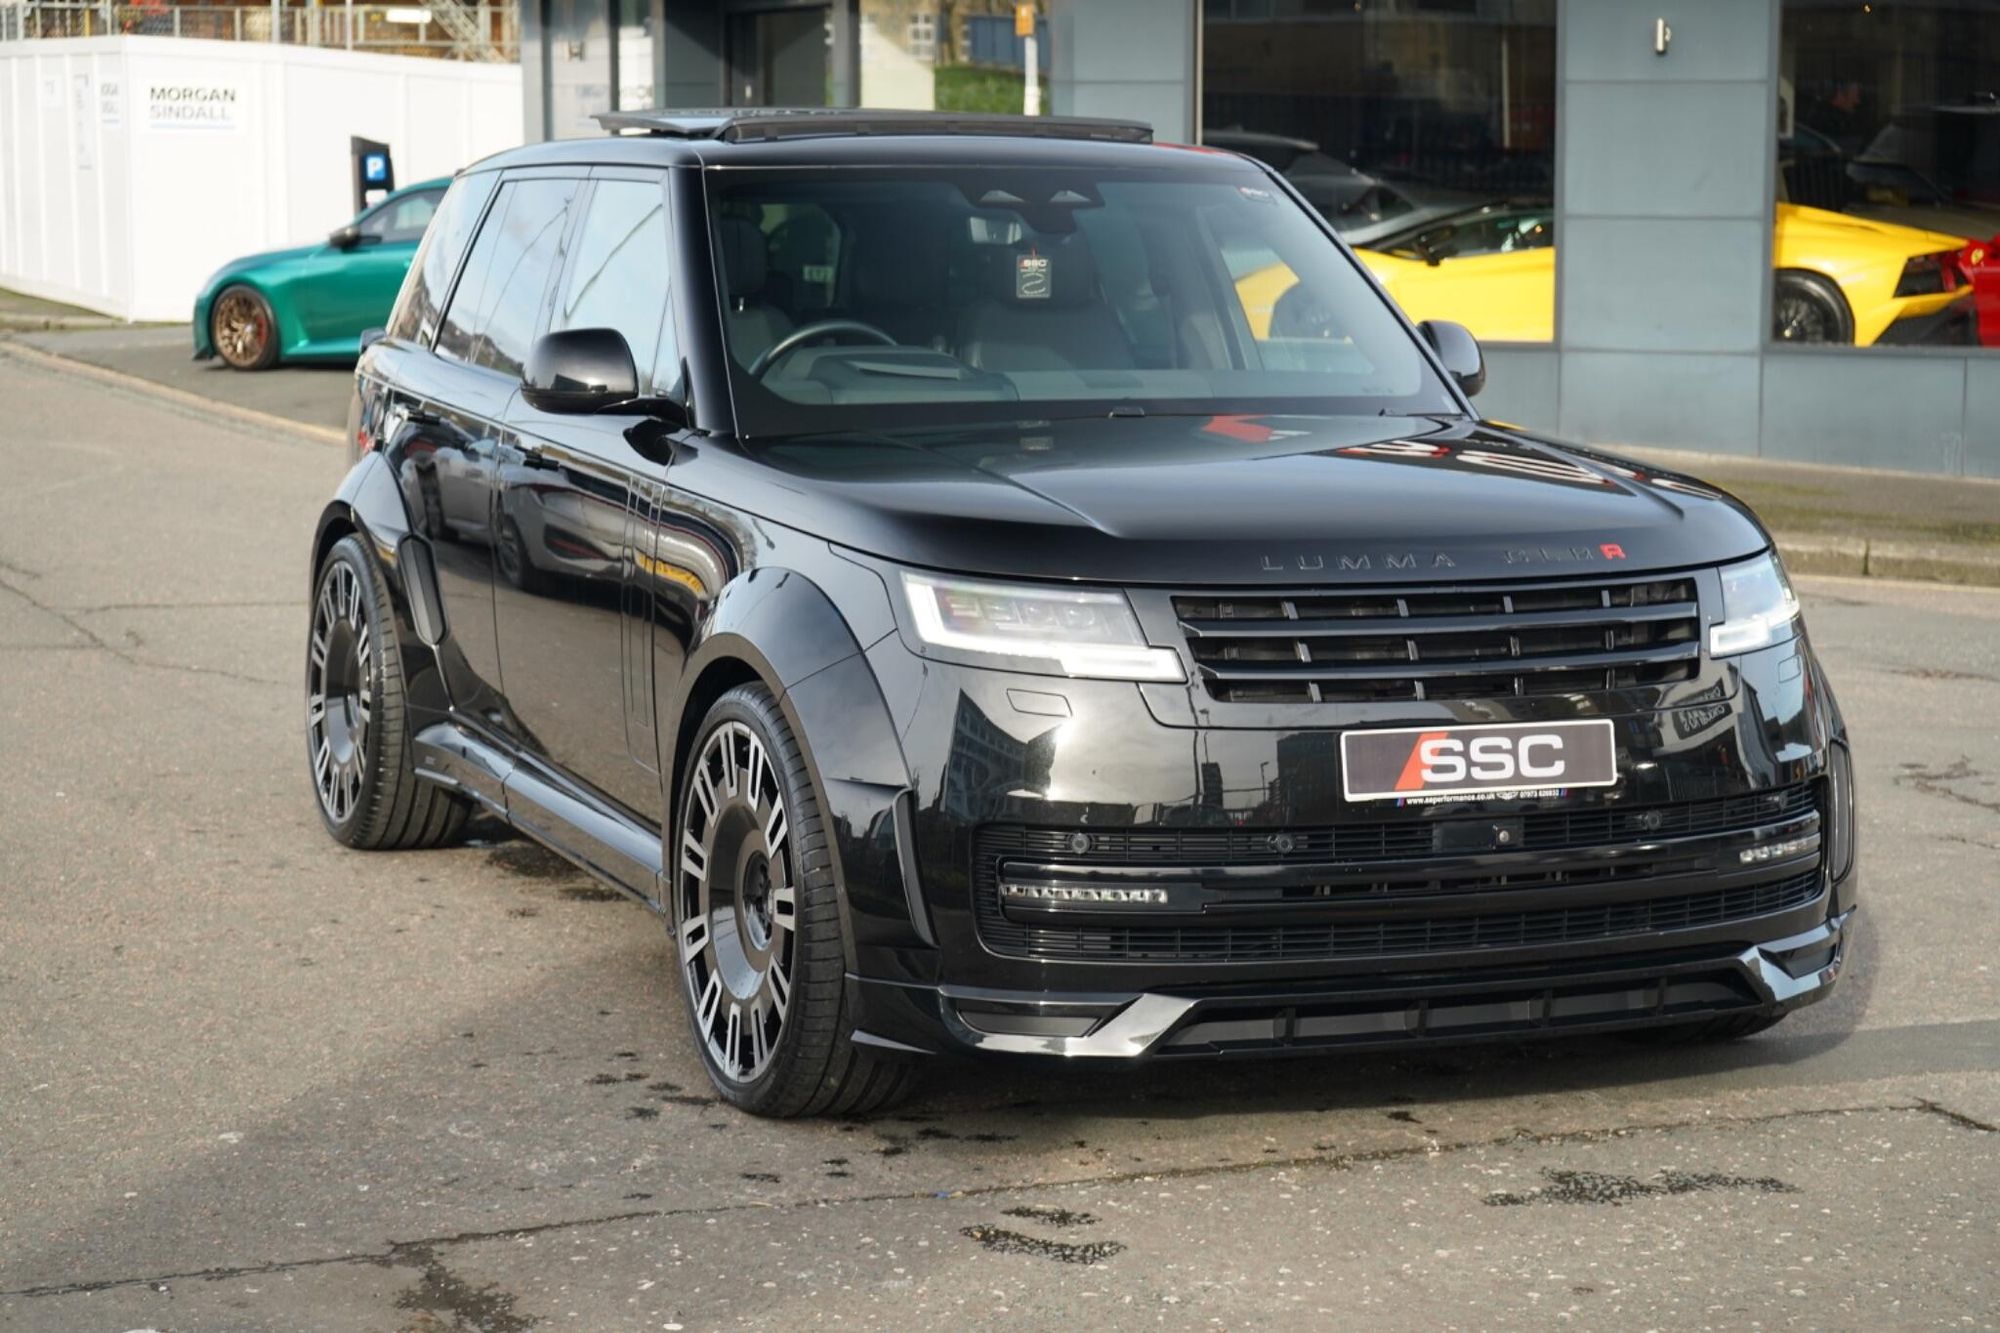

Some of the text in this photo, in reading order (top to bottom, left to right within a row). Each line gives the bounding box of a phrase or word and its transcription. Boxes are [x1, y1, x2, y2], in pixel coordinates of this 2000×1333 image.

[150, 87, 236, 102] MORGAN
[149, 105, 231, 120] SINDALL
[367, 156, 384, 179] P
[1260, 551, 1456, 571] LUMMA
[1419, 734, 1566, 783] SSC
